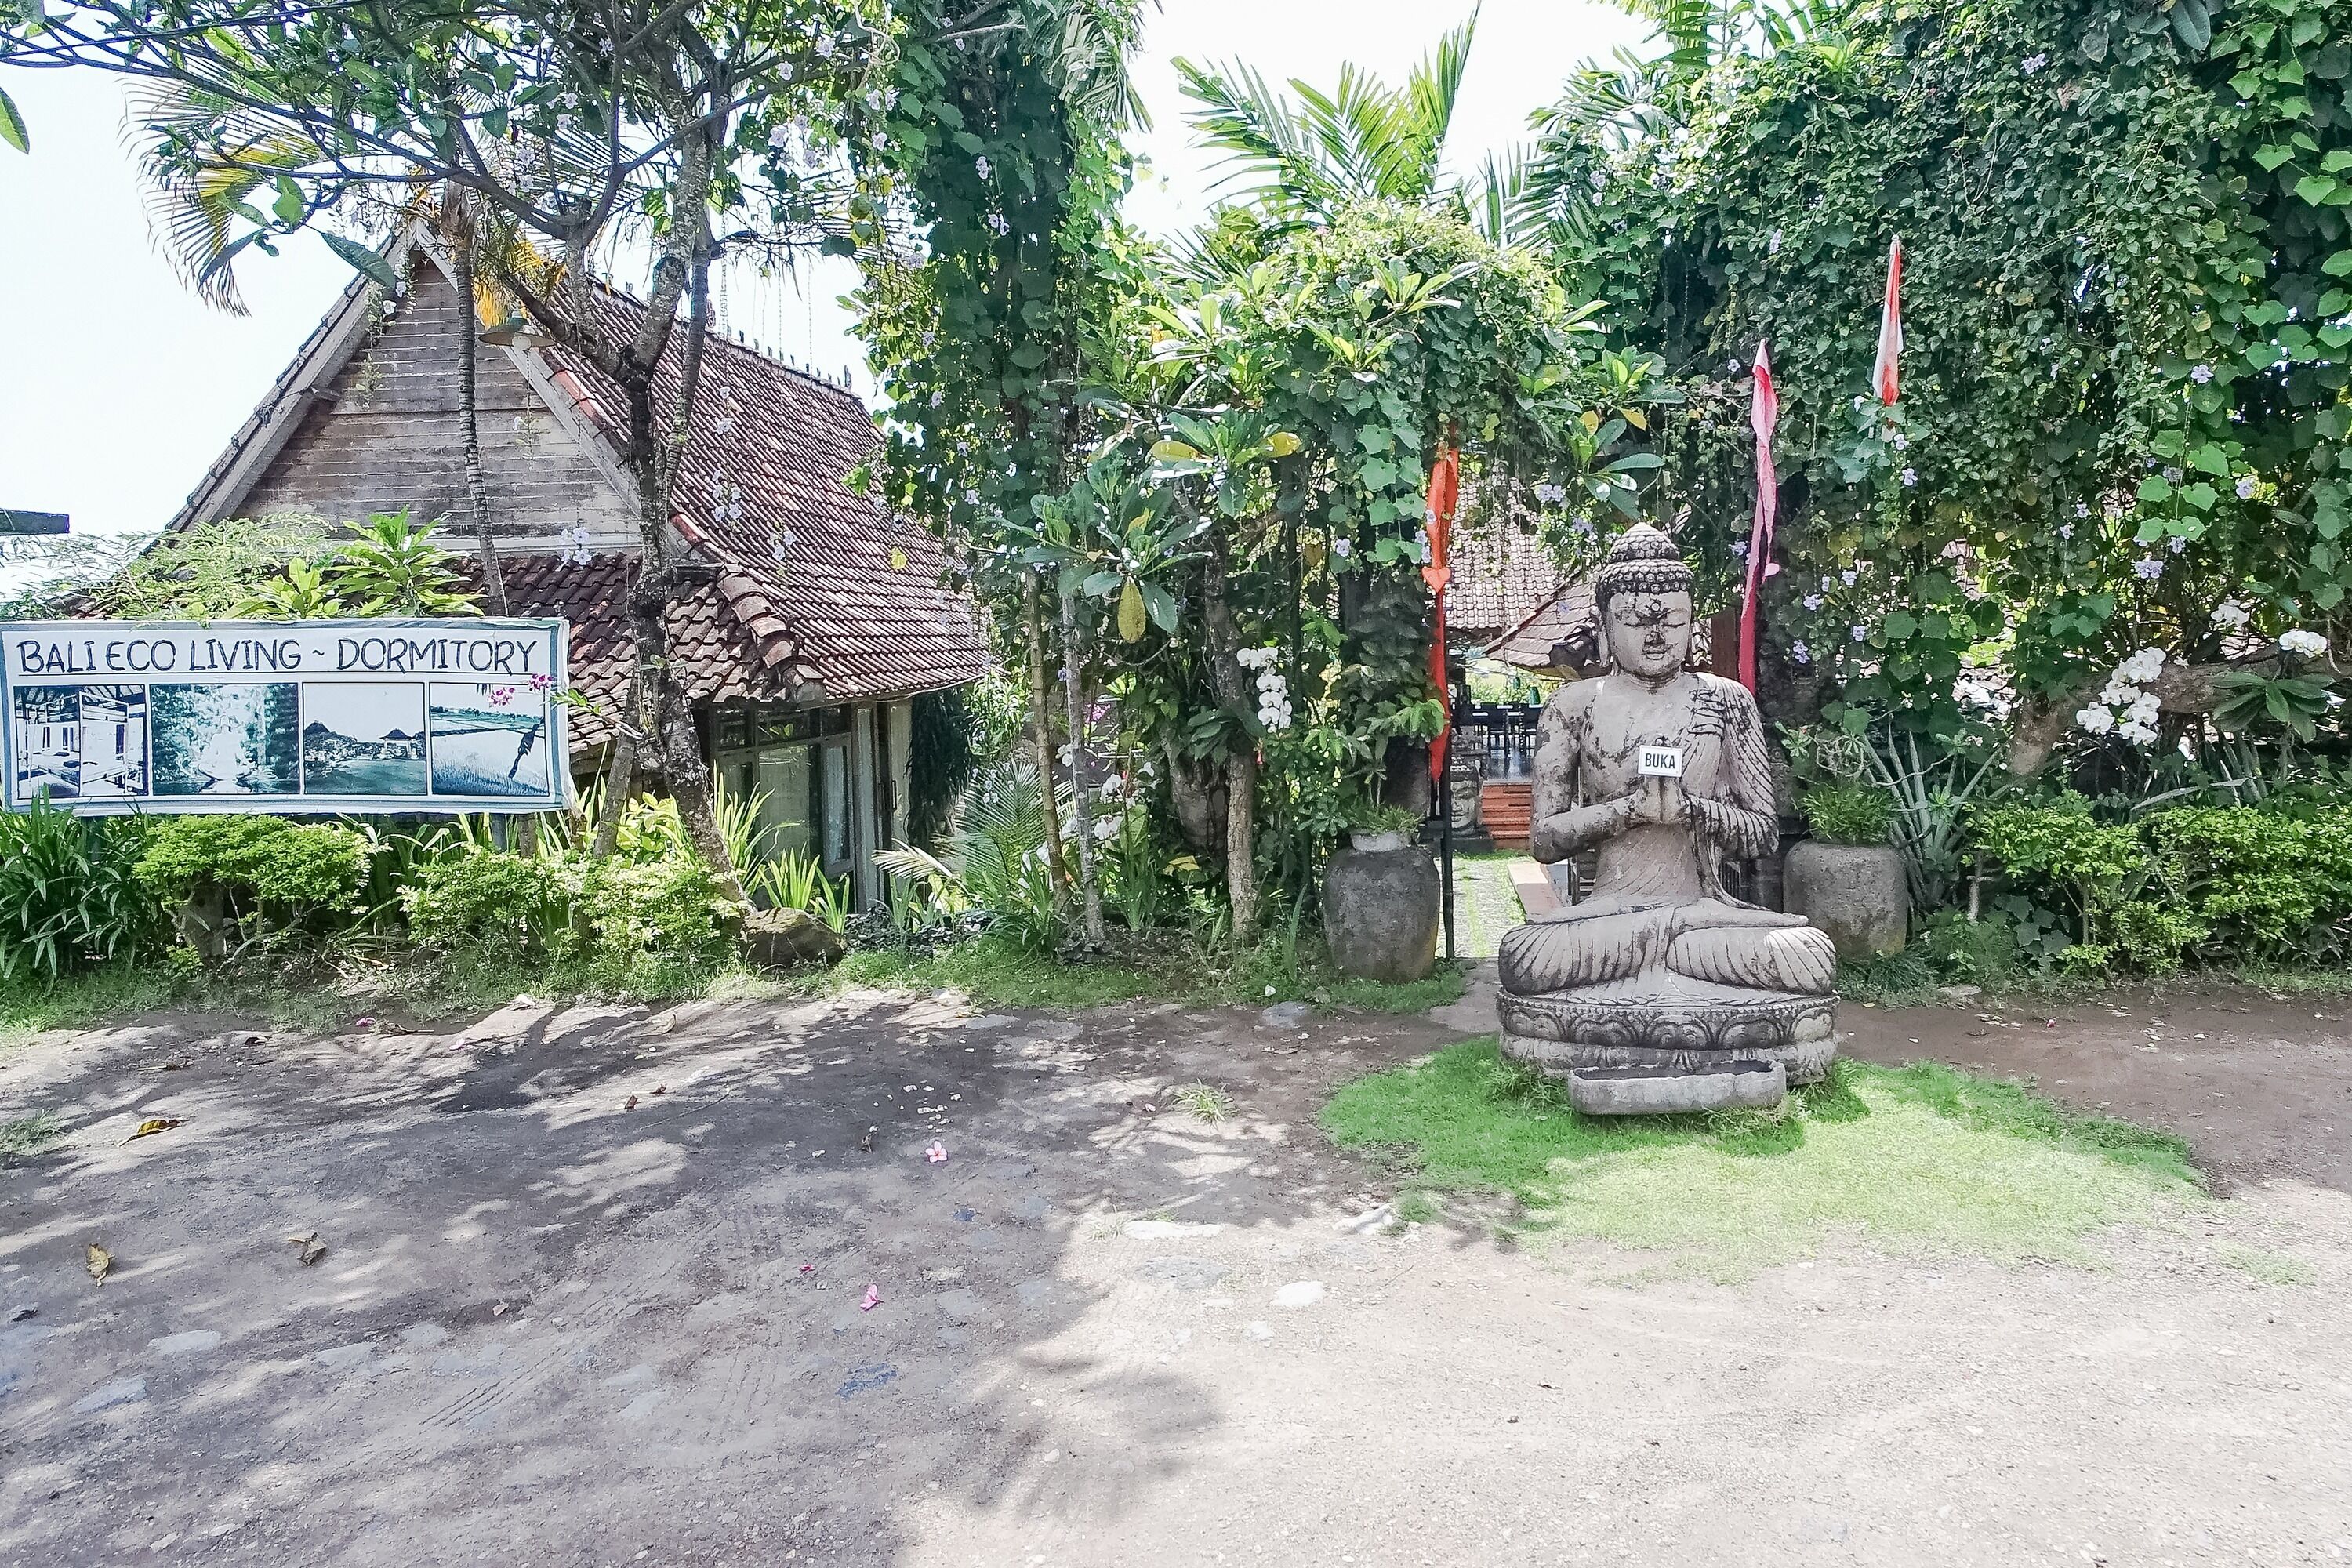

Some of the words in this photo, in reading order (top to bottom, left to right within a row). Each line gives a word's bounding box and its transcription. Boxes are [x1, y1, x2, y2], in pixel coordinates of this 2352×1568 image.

[16, 640, 96, 673] BALI
[105, 639, 176, 671] ECO
[189, 638, 302, 671] LIVING
[336, 637, 538, 676] DORMITORY
[1645, 753, 1675, 769] BUKA
